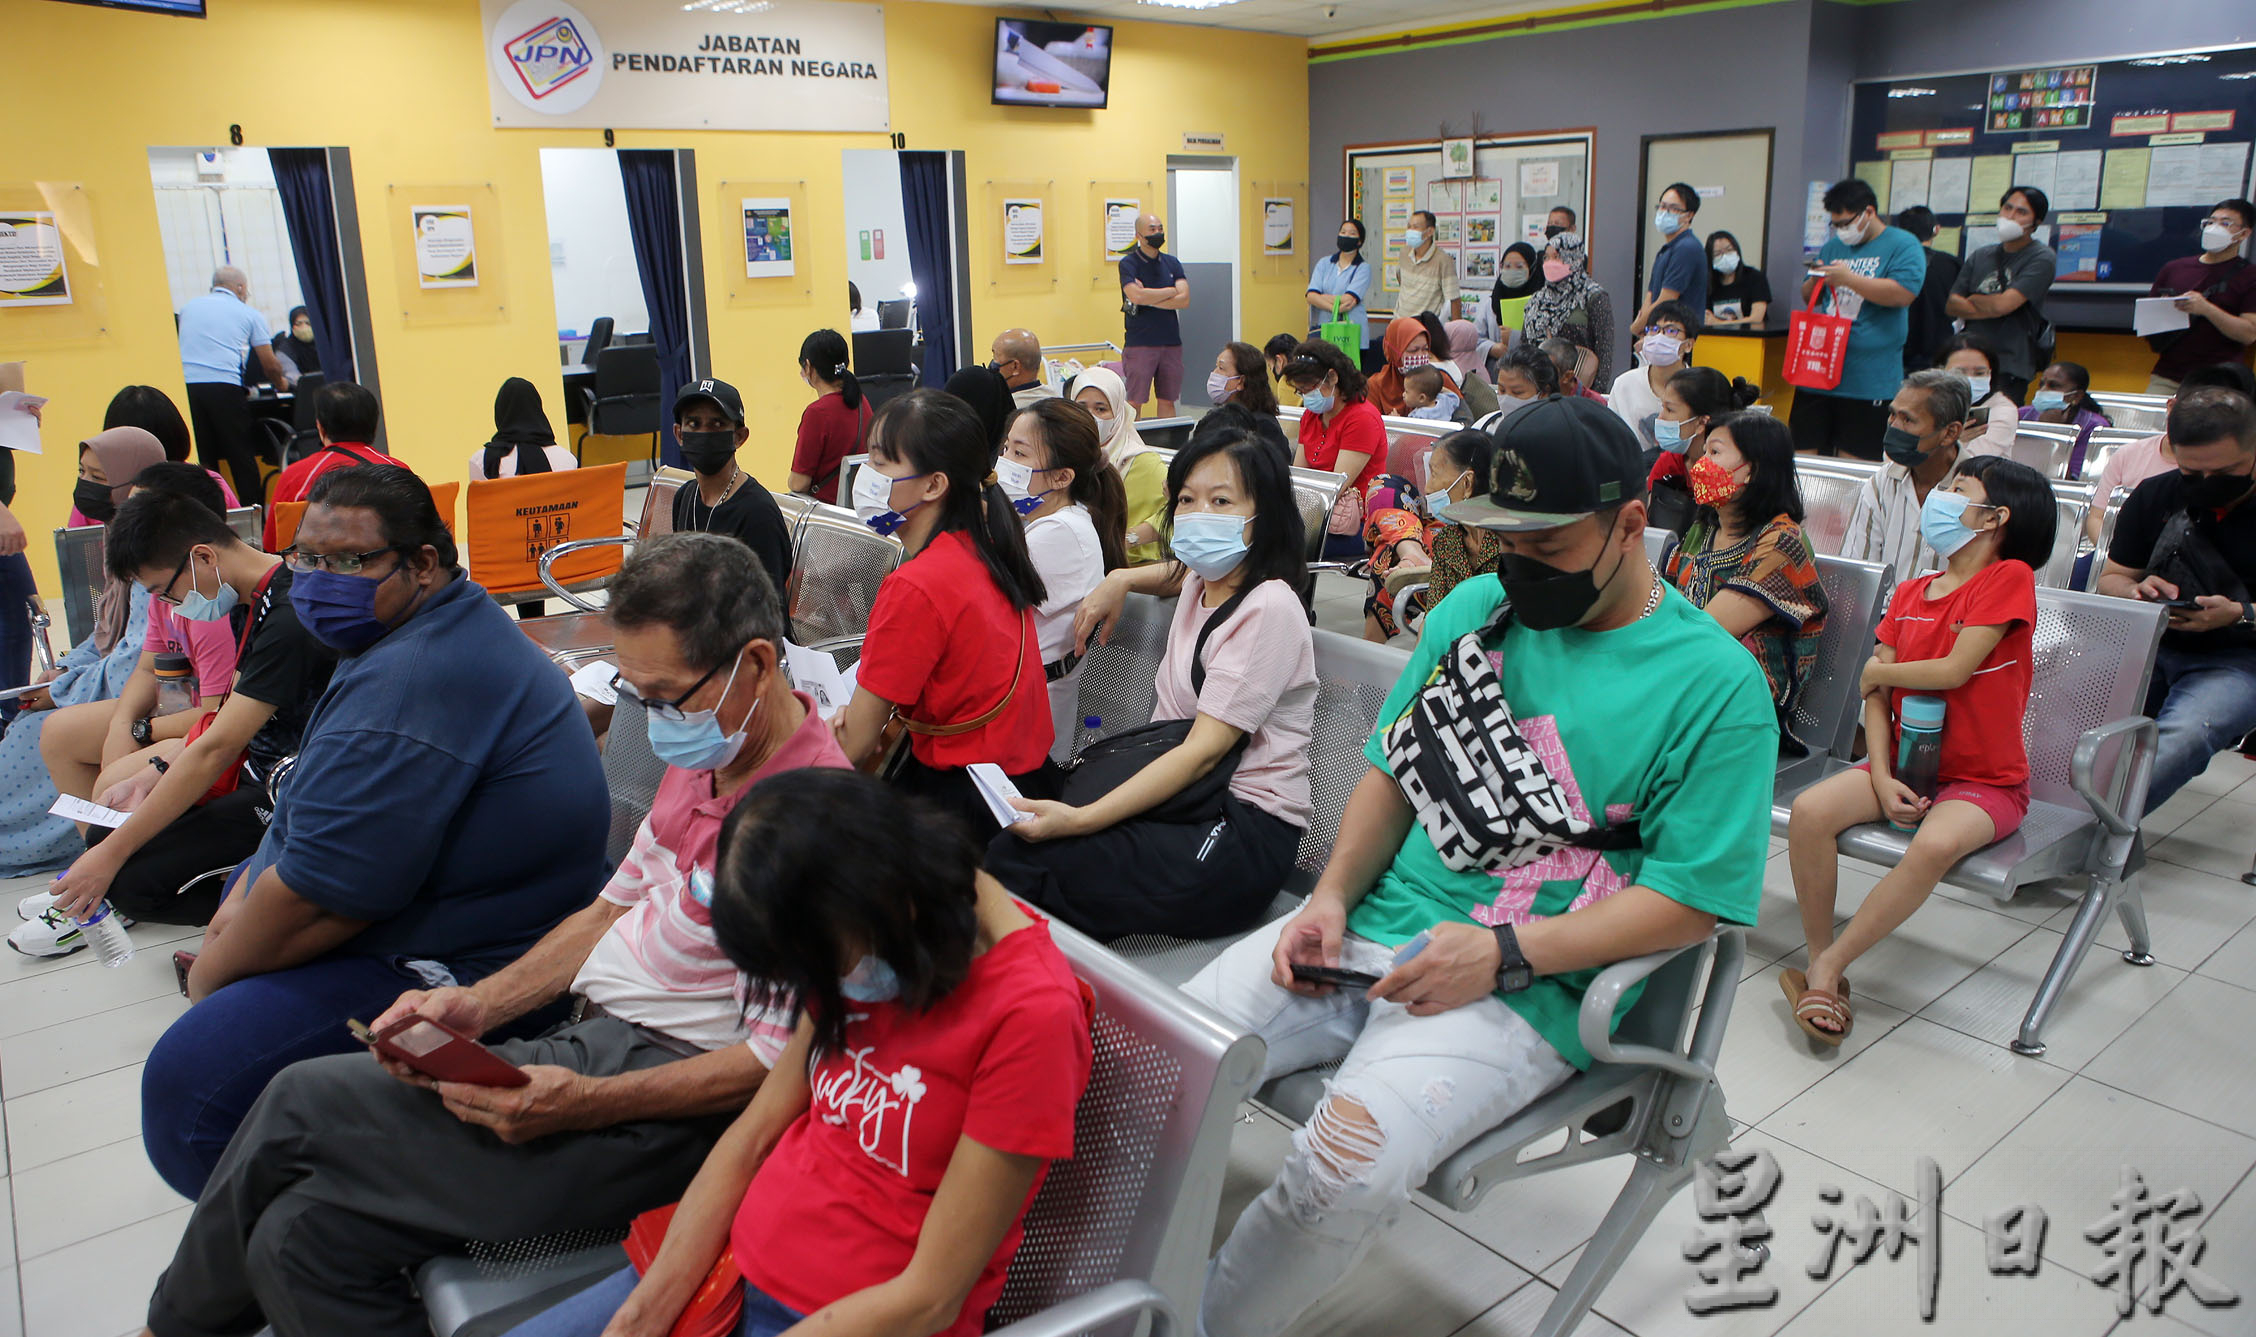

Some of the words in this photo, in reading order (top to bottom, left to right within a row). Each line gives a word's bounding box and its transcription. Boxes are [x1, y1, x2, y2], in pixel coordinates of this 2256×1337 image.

[513, 45, 584, 66] JPN
[698, 35, 801, 55] JABATAN
[612, 53, 784, 76] PENDAFTARAN
[791, 61, 878, 80] NEGARA
[230, 124, 243, 146] 8
[604, 128, 615, 150] 9
[890, 132, 905, 150] 10
[516, 501, 579, 517] KEUTAMAAN
